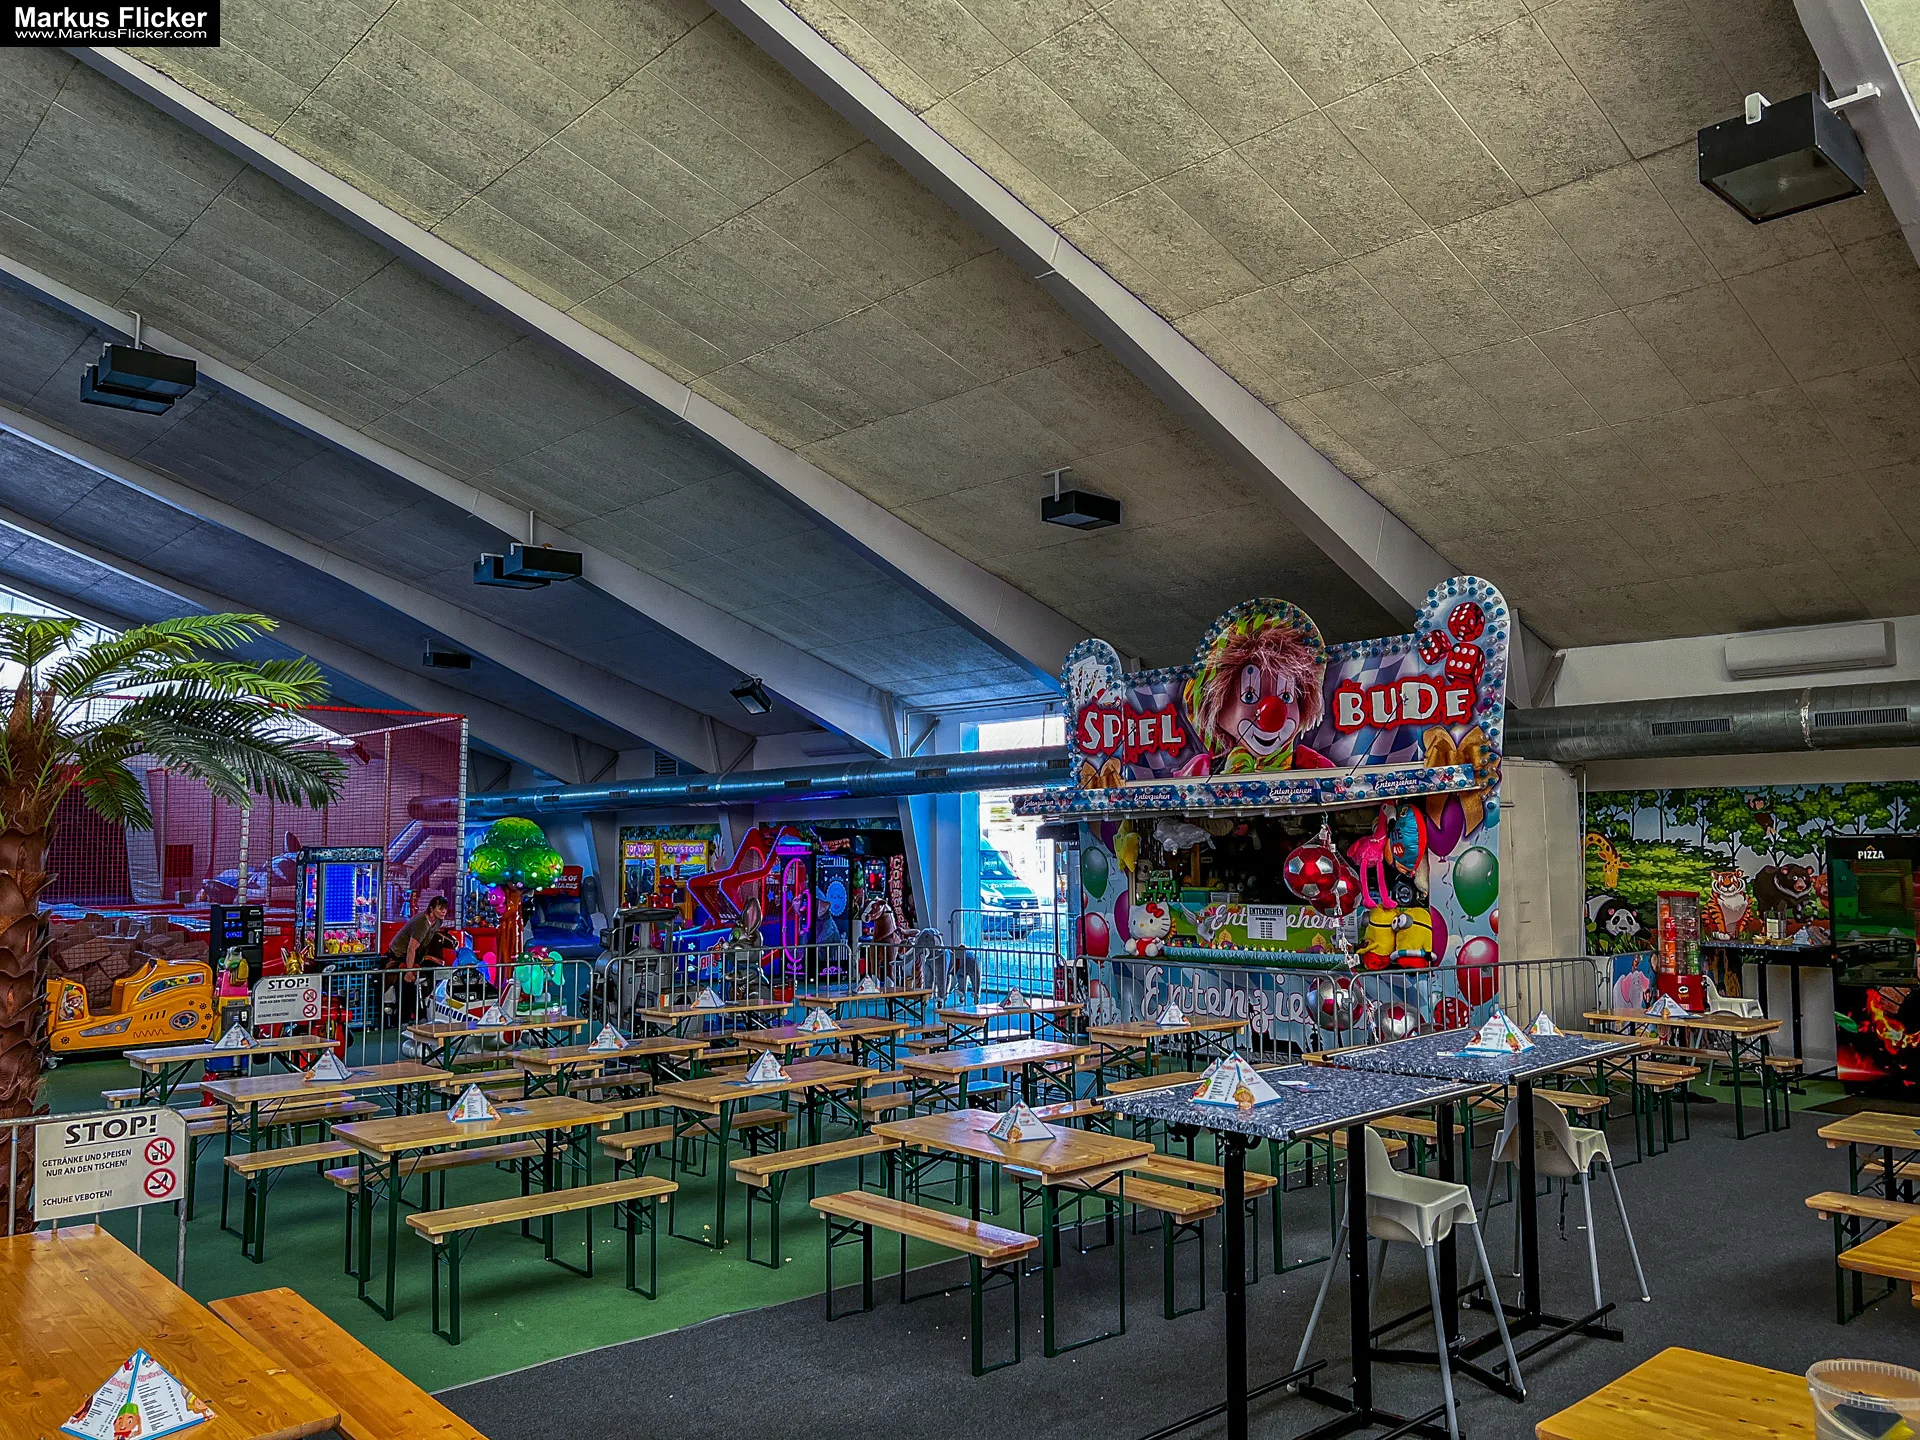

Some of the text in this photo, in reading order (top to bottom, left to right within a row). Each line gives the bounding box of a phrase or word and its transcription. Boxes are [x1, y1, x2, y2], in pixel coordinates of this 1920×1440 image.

[1082, 682, 1469, 749] SPIEL BUDE
[680, 845, 704, 853] STORY
[1858, 851, 1885, 859] PIZZA
[1249, 907, 1284, 916] ENTENZIEHEN
[268, 978, 309, 989] STOP!
[66, 1114, 157, 1144] STOP!
[42, 1148, 132, 1167] GETRÄNKE UND SPEISEN
[46, 1159, 128, 1177] NUR AN DEN TISCHEN!
[42, 1189, 113, 1206] SCHUHE VEBOTEN!
